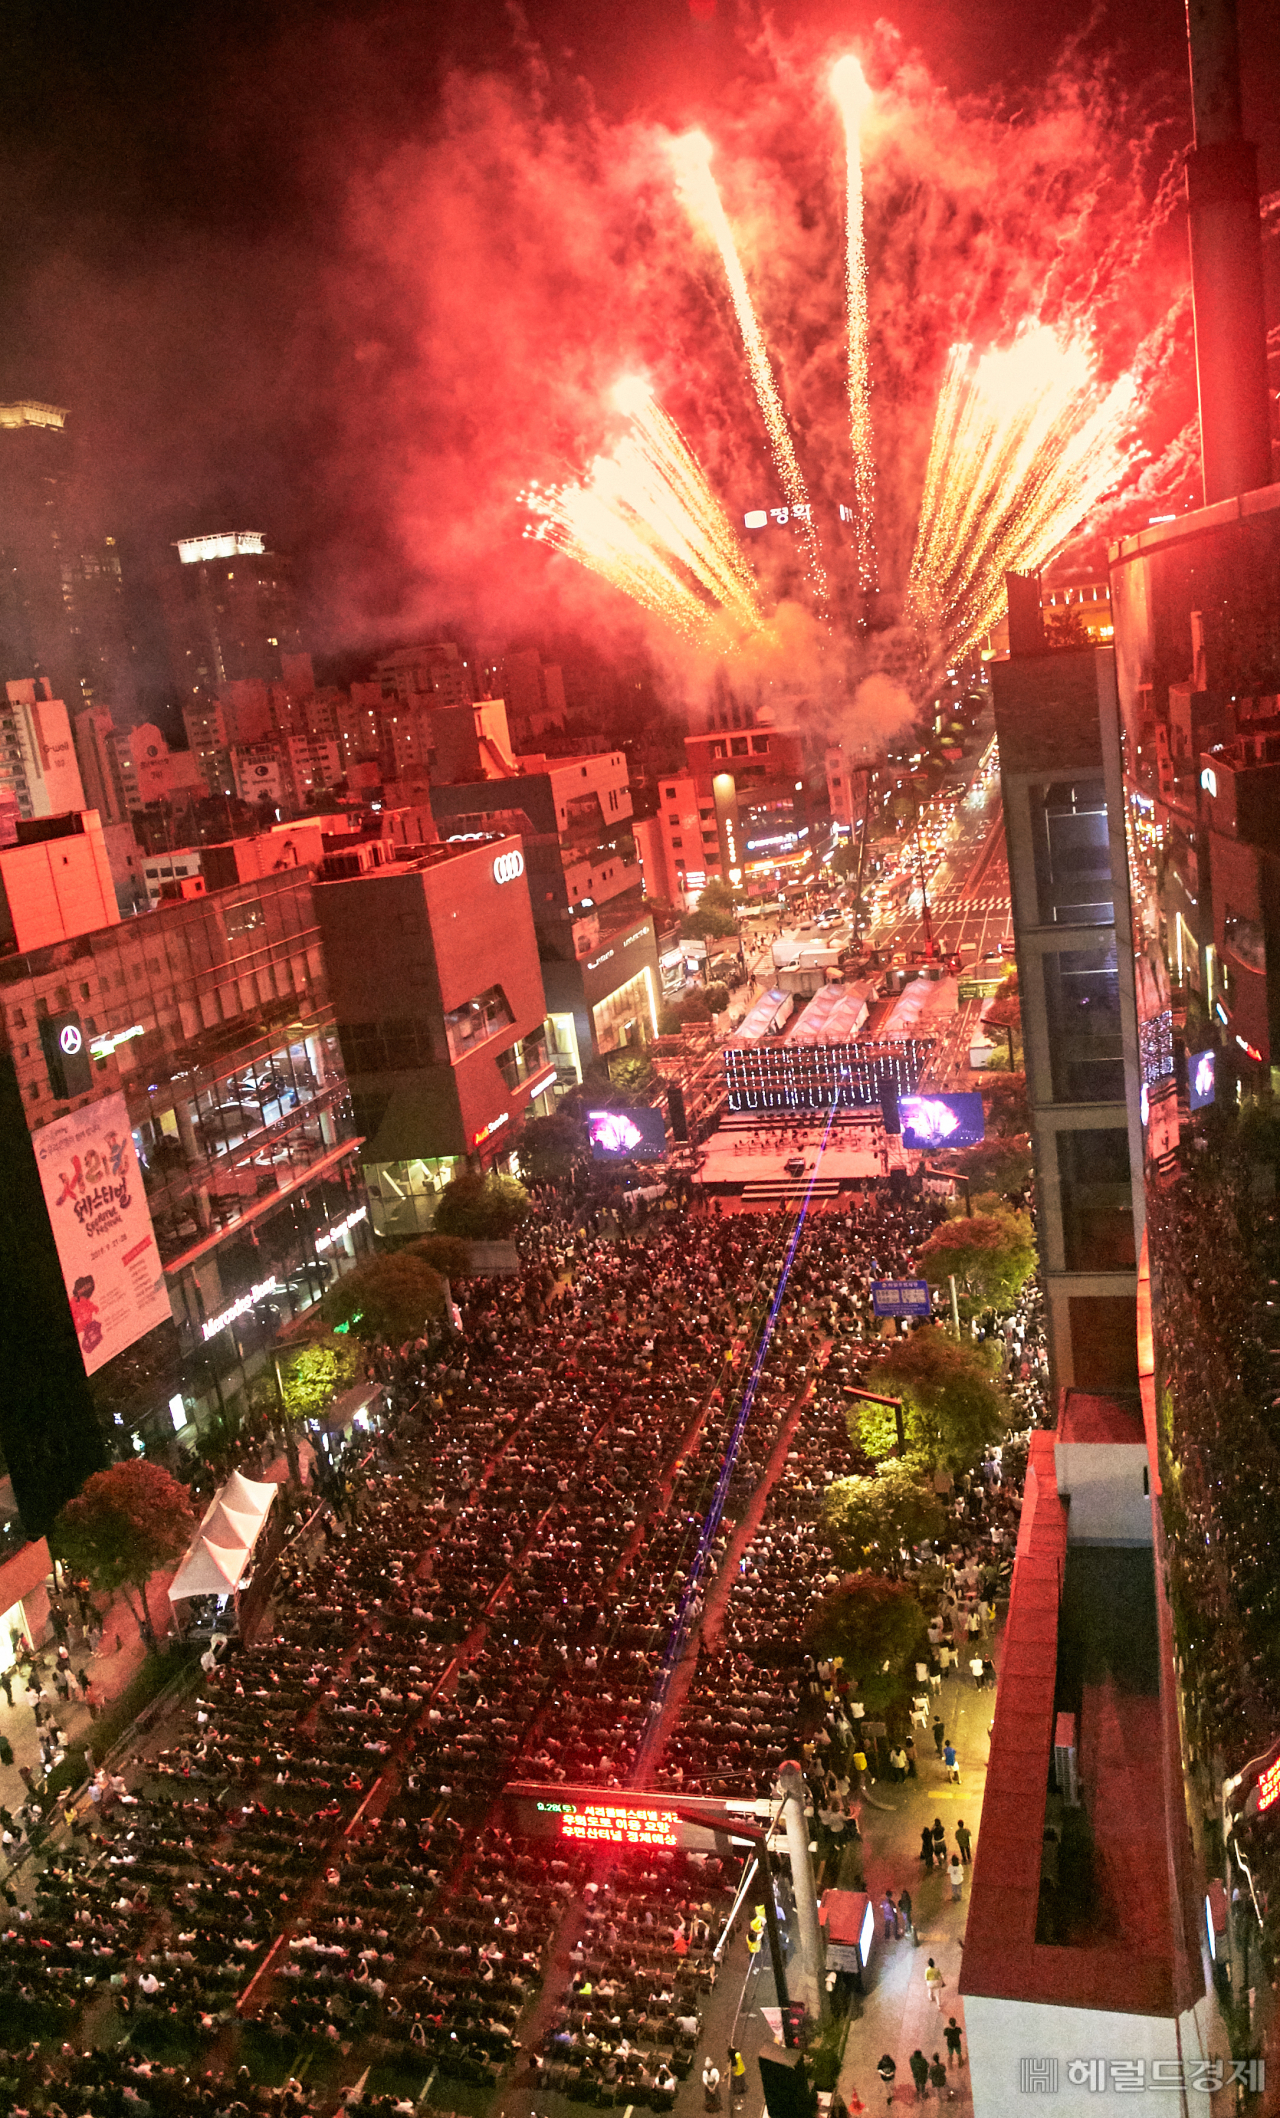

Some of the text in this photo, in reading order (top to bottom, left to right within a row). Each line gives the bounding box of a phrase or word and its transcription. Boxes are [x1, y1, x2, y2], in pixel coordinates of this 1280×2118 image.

[202, 1276, 276, 1341] Mercedes-Benz
[563, 1814, 670, 1833] 우회도로 이용 요망
[562, 1826, 677, 1846] 우면산터널 정체예상
